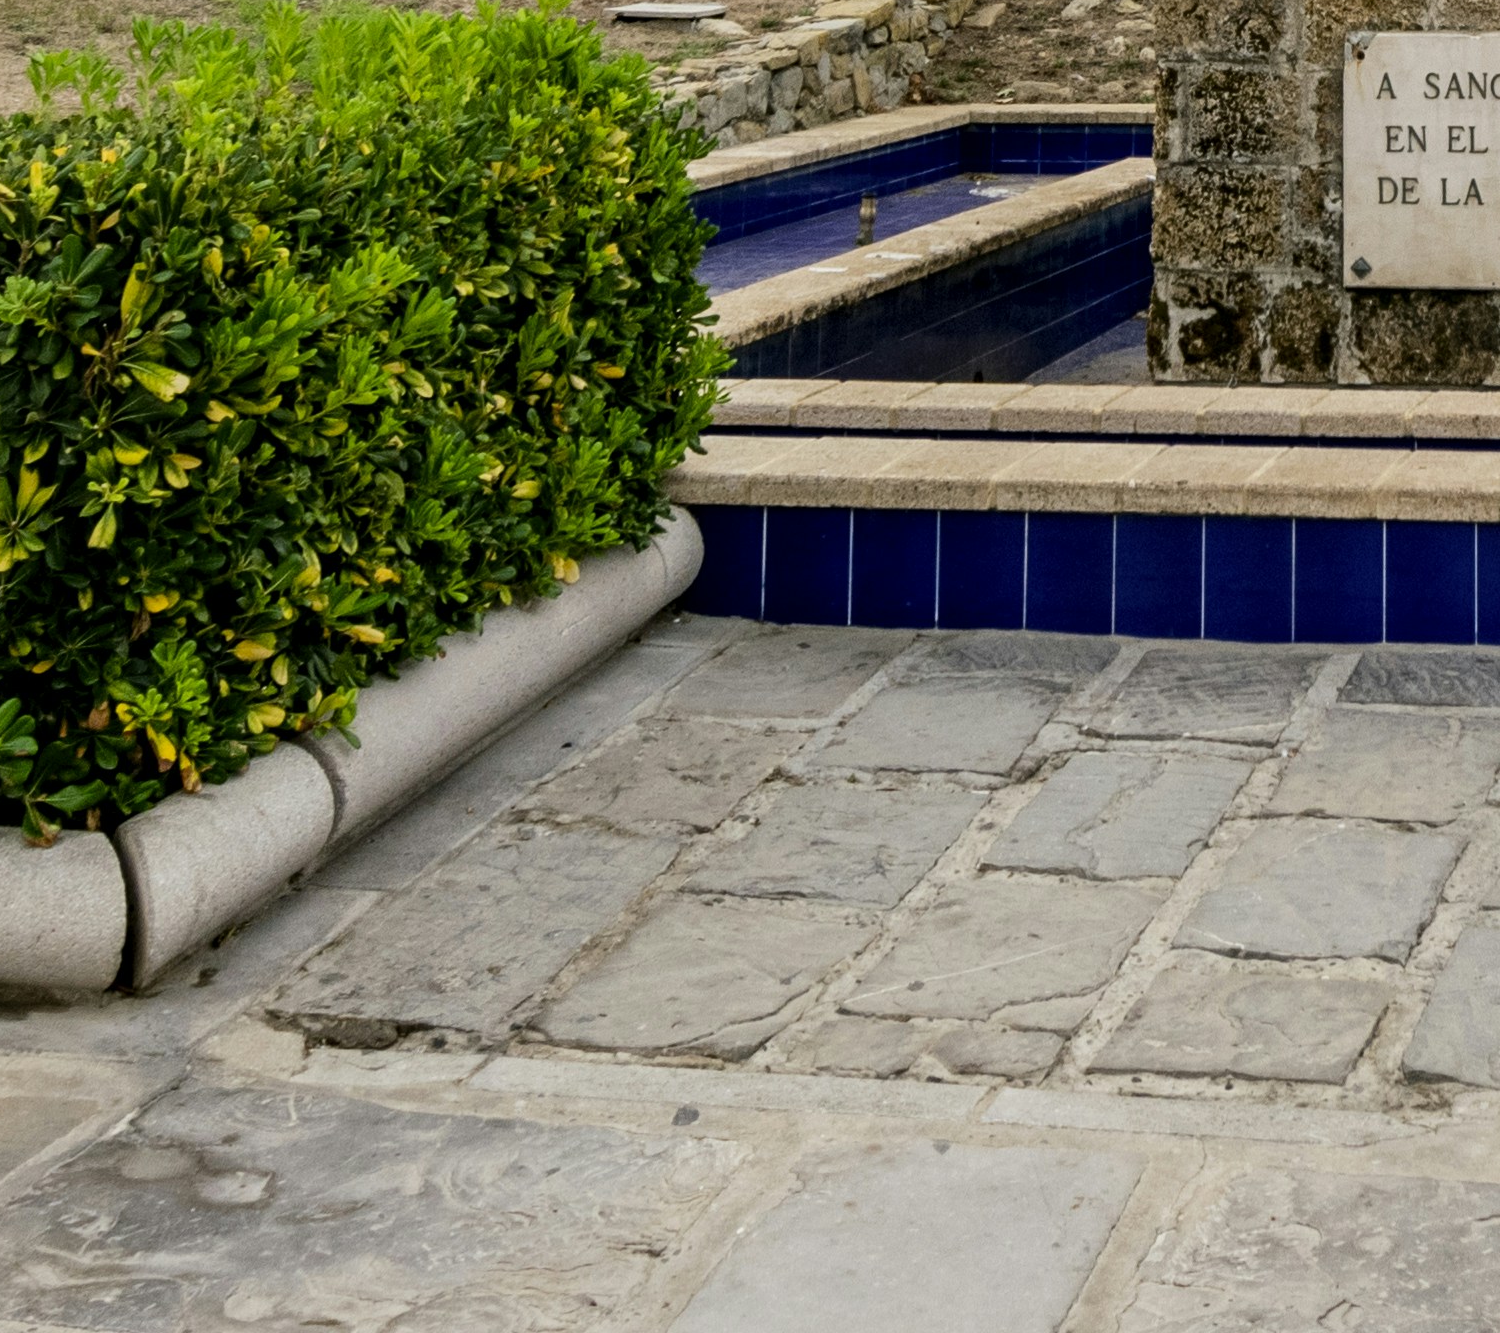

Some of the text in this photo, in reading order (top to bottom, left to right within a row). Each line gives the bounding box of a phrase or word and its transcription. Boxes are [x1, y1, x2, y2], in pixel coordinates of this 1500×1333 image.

[1375, 71, 1398, 101] A
[1384, 124, 1428, 155] EN
[1446, 124, 1490, 156] EL
[1376, 175, 1421, 206] DE
[1439, 176, 1486, 208] LA
